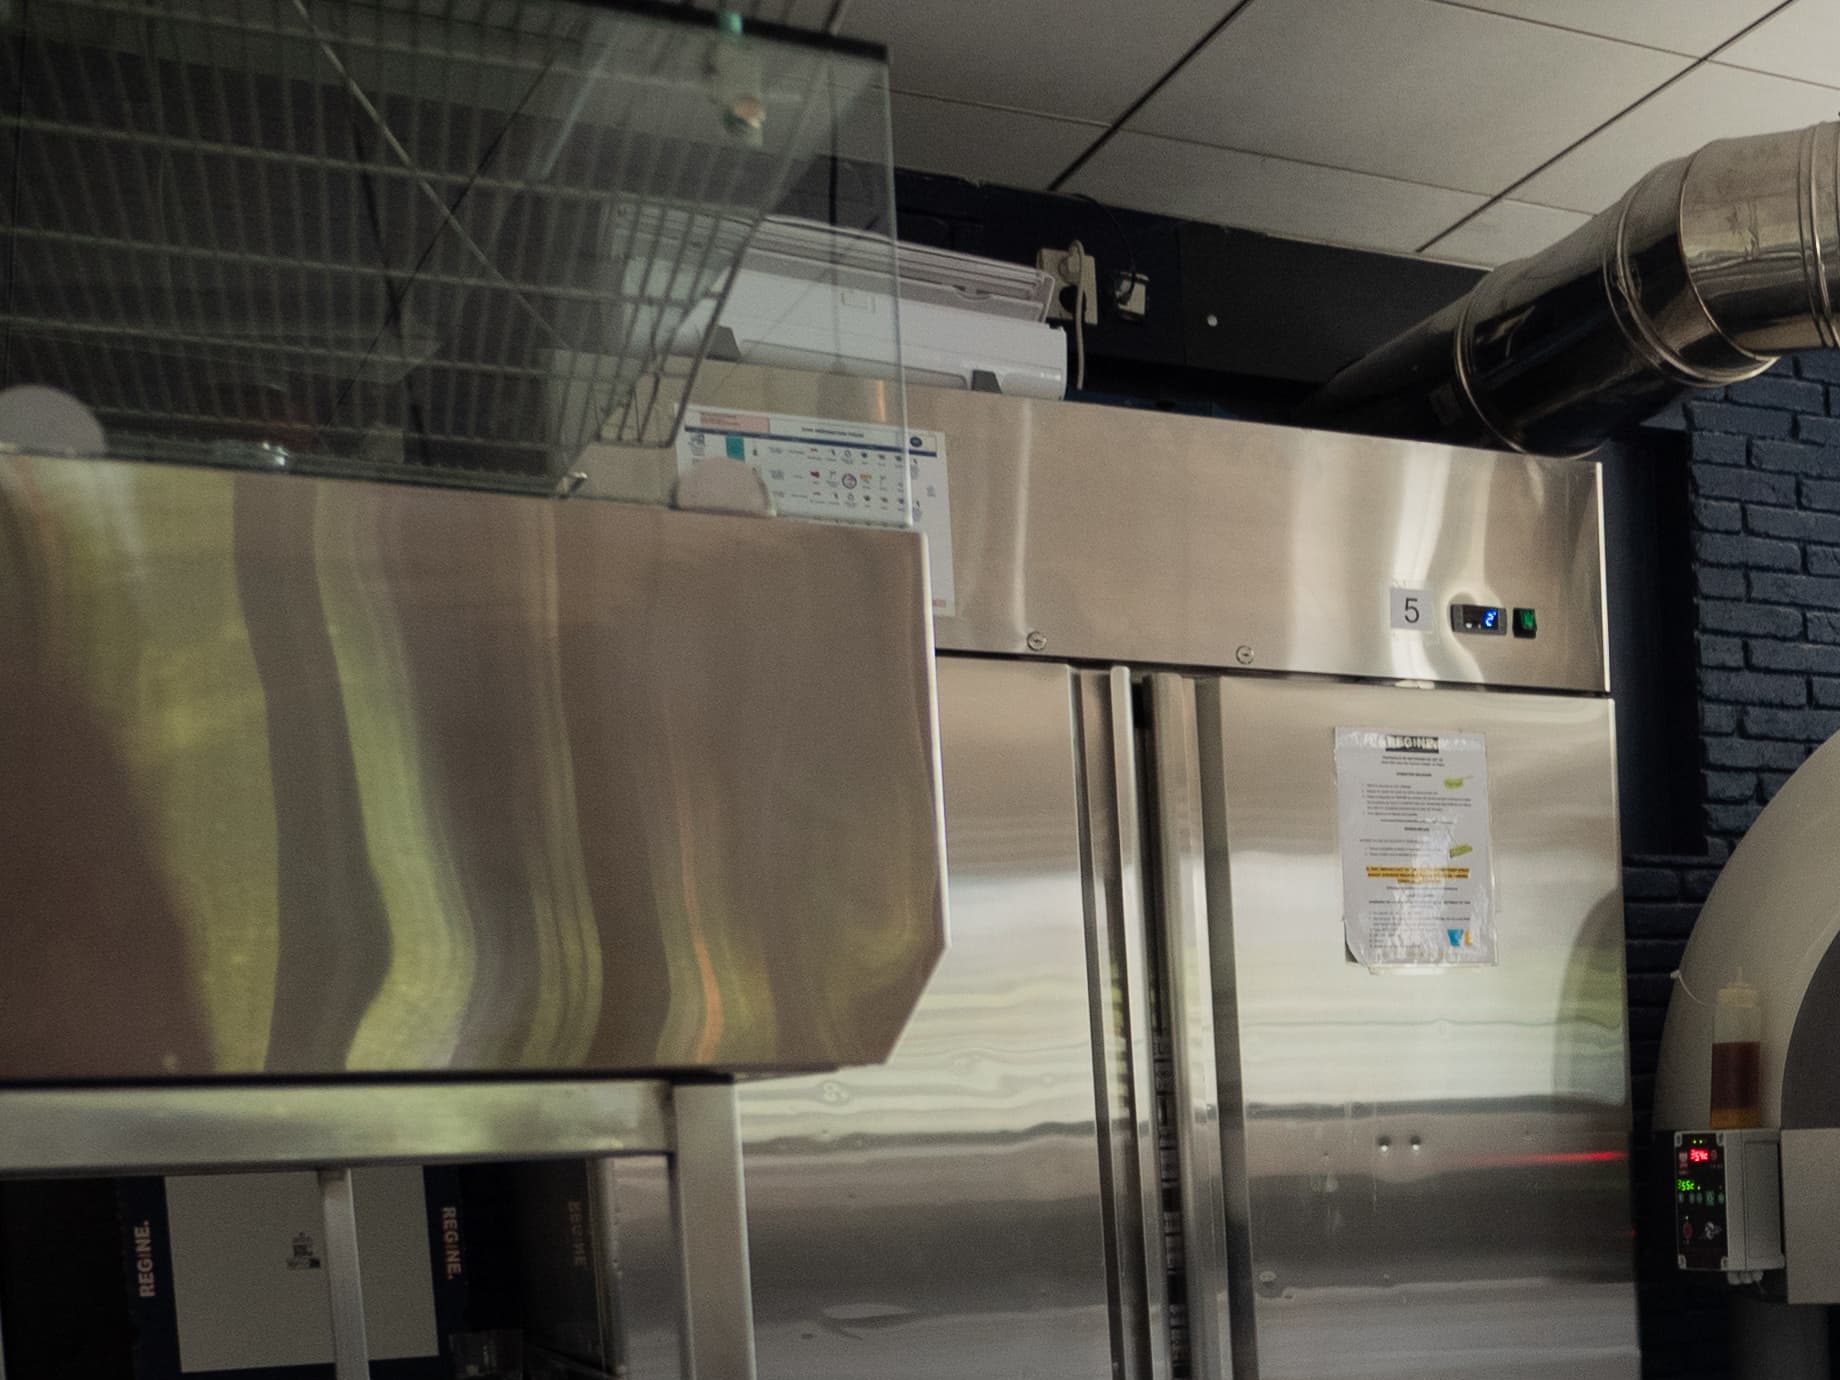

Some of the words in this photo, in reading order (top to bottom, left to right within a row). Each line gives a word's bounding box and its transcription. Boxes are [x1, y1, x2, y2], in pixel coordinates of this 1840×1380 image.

[1403, 597, 1421, 624] 5
[133, 1219, 156, 1299] REGINE.
[440, 1205, 463, 1281] REGINE.
